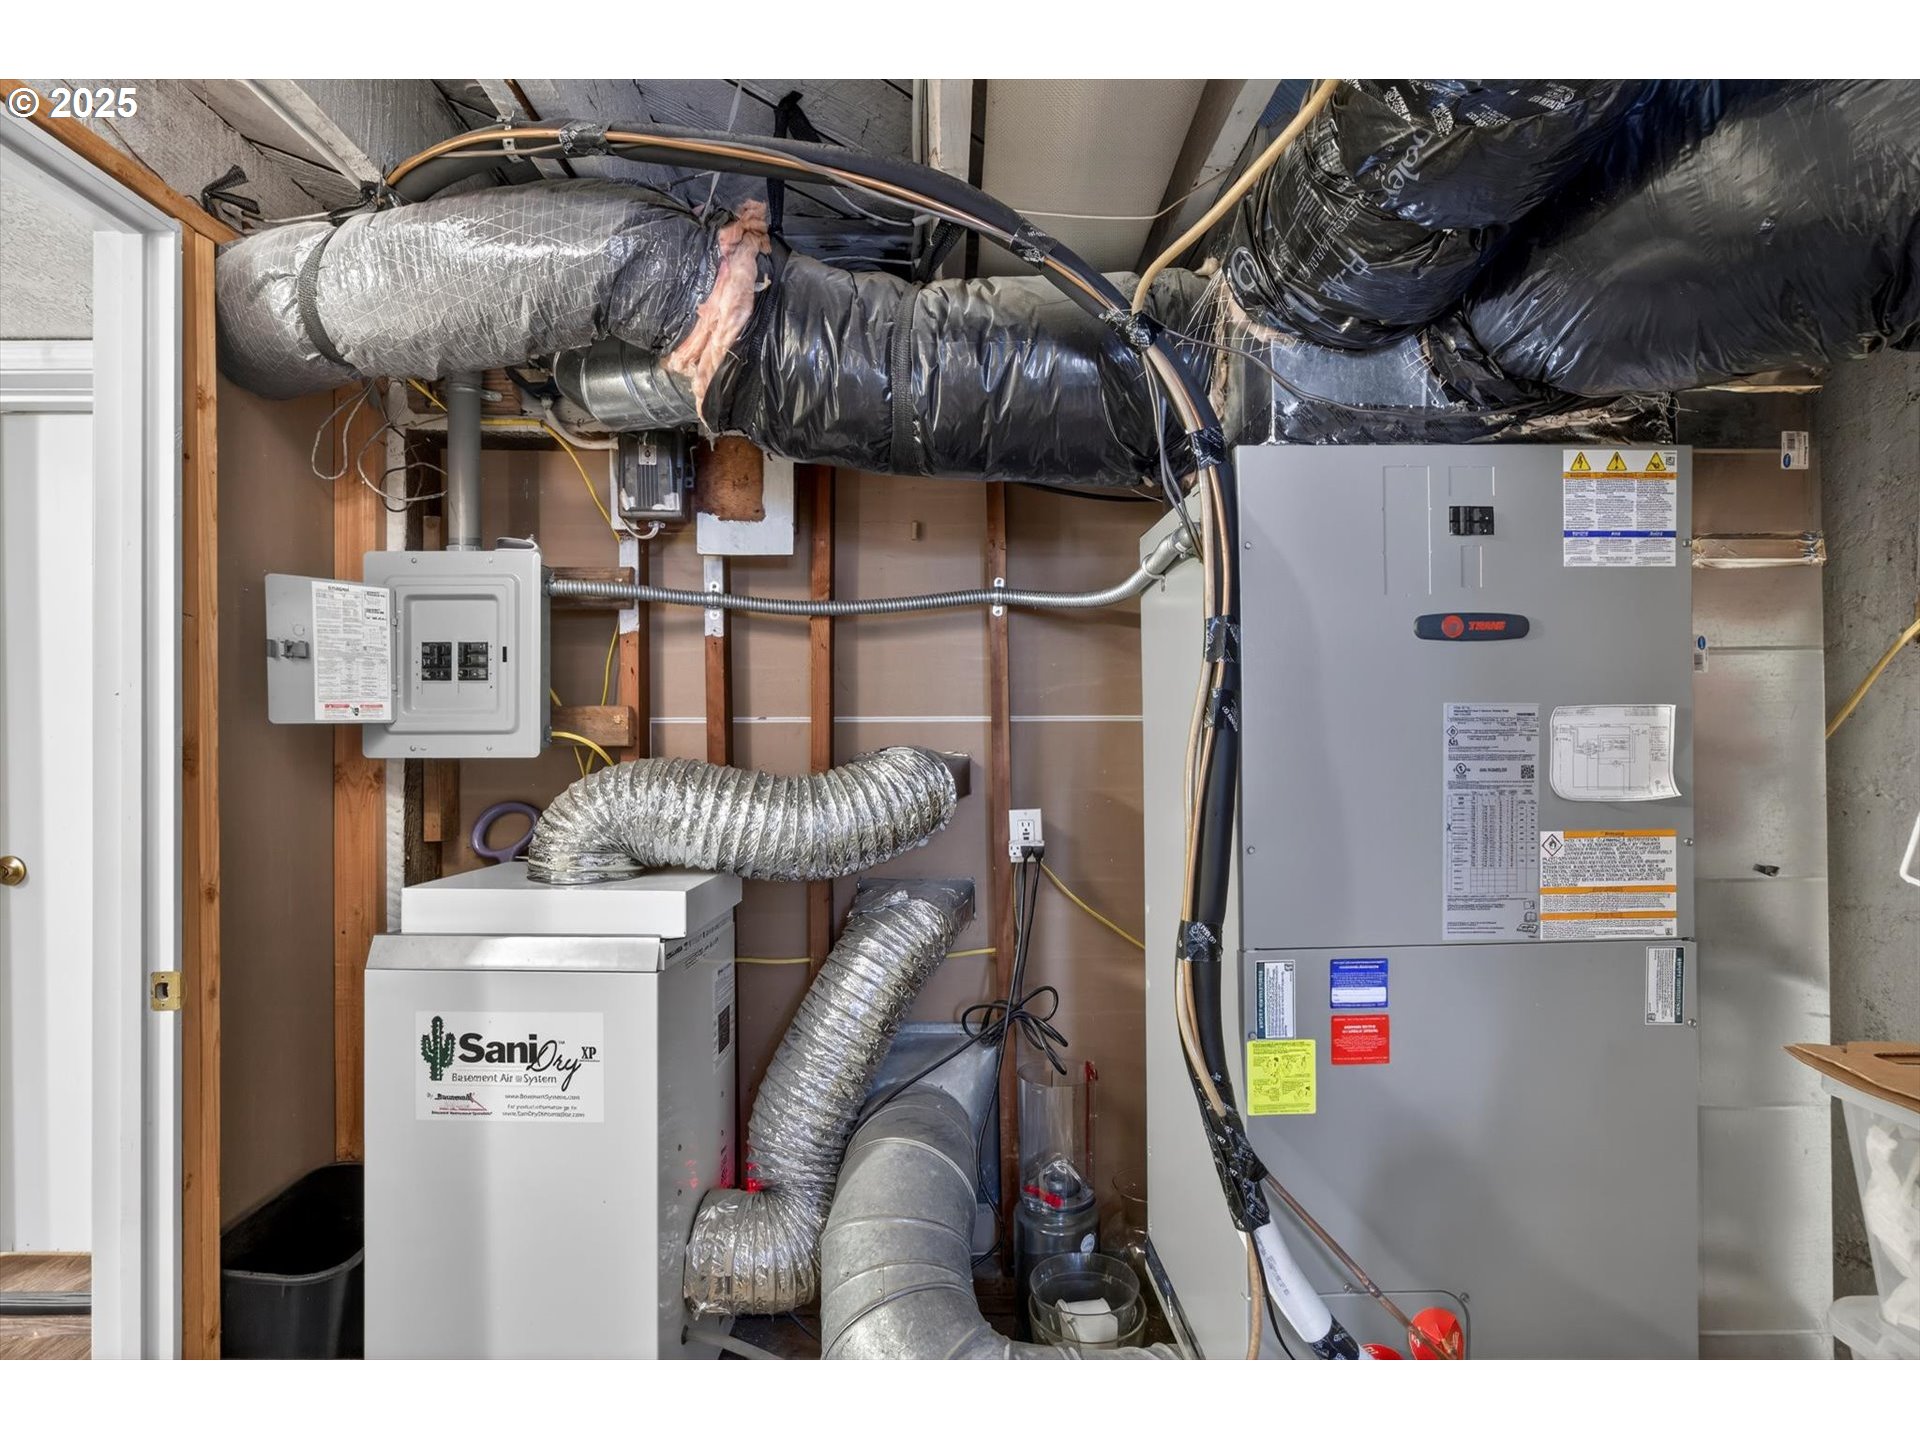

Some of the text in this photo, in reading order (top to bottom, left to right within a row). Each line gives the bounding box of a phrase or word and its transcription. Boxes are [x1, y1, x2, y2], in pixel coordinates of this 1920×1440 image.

[581, 1046, 597, 1059] XP
[452, 1073, 557, 1086] Basement Air System
